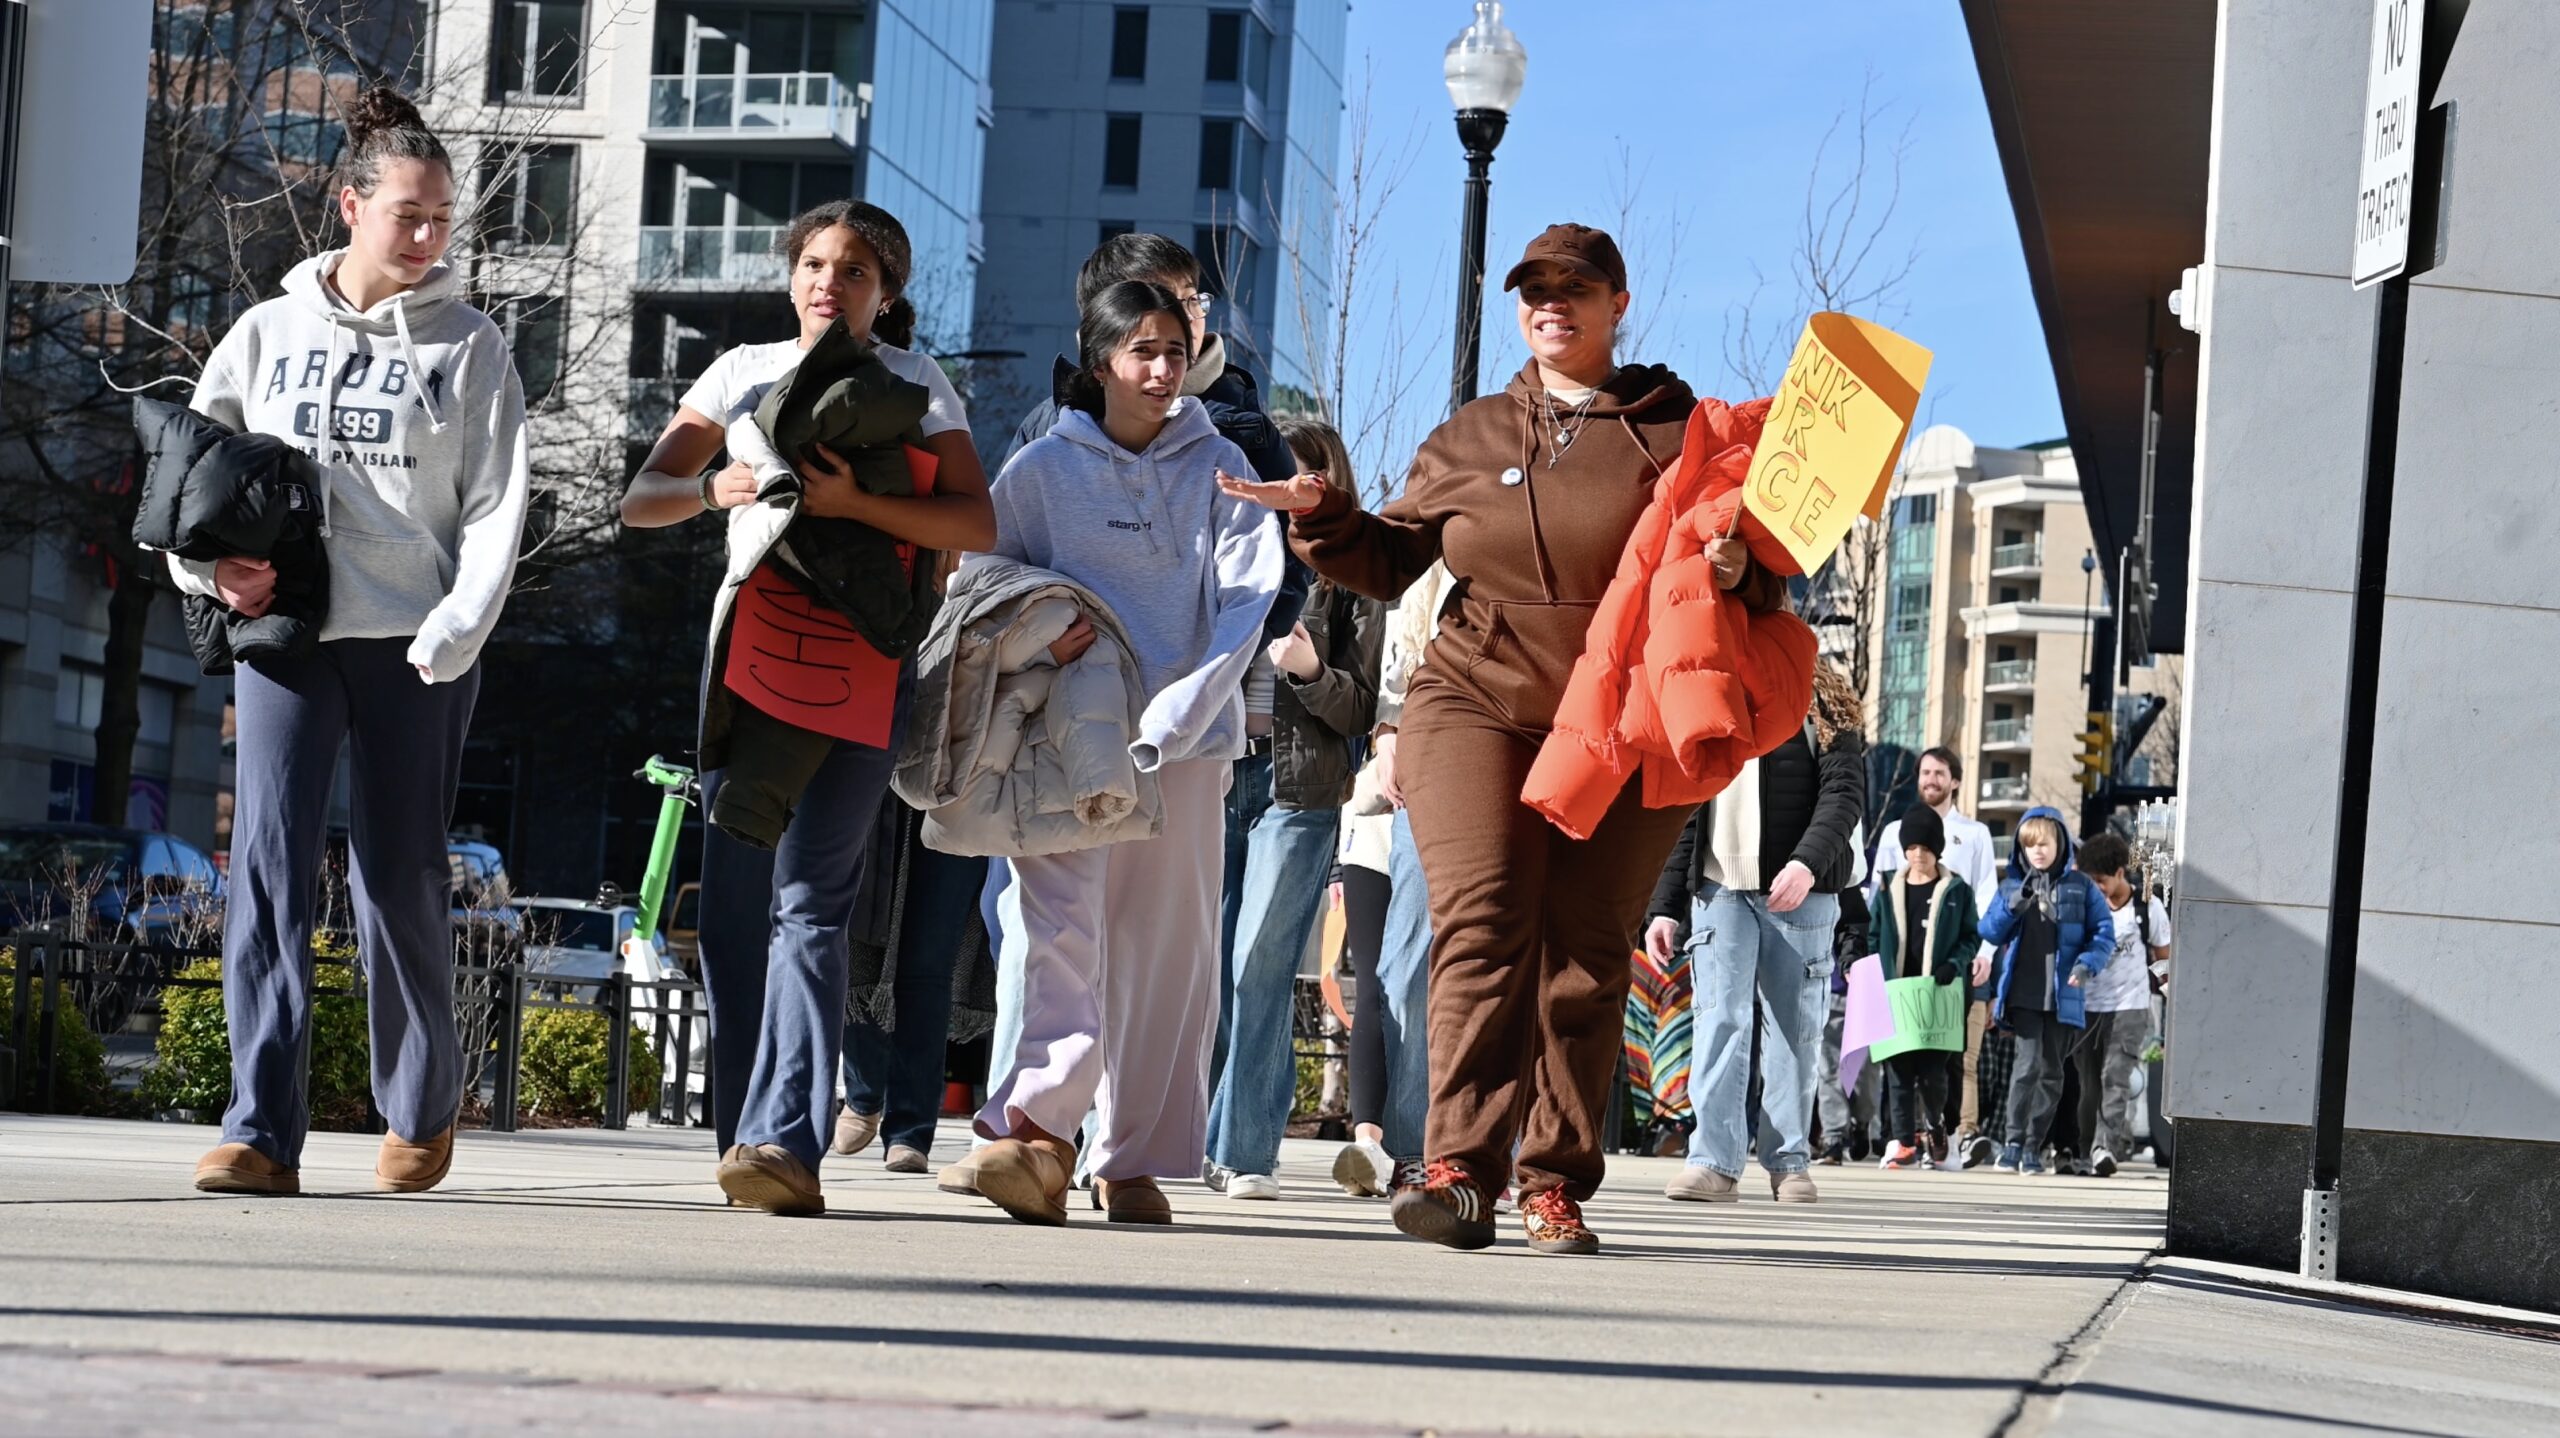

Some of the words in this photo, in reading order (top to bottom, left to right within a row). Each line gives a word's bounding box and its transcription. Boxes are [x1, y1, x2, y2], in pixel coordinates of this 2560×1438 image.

[2384, 0, 2408, 75] NO
[2374, 95, 2407, 162] THRU
[2360, 172, 2408, 244] TRAFFIC
[264, 349, 446, 413] ARUBA
[1788, 338, 1862, 433] NK
[1757, 451, 1836, 547] CE
